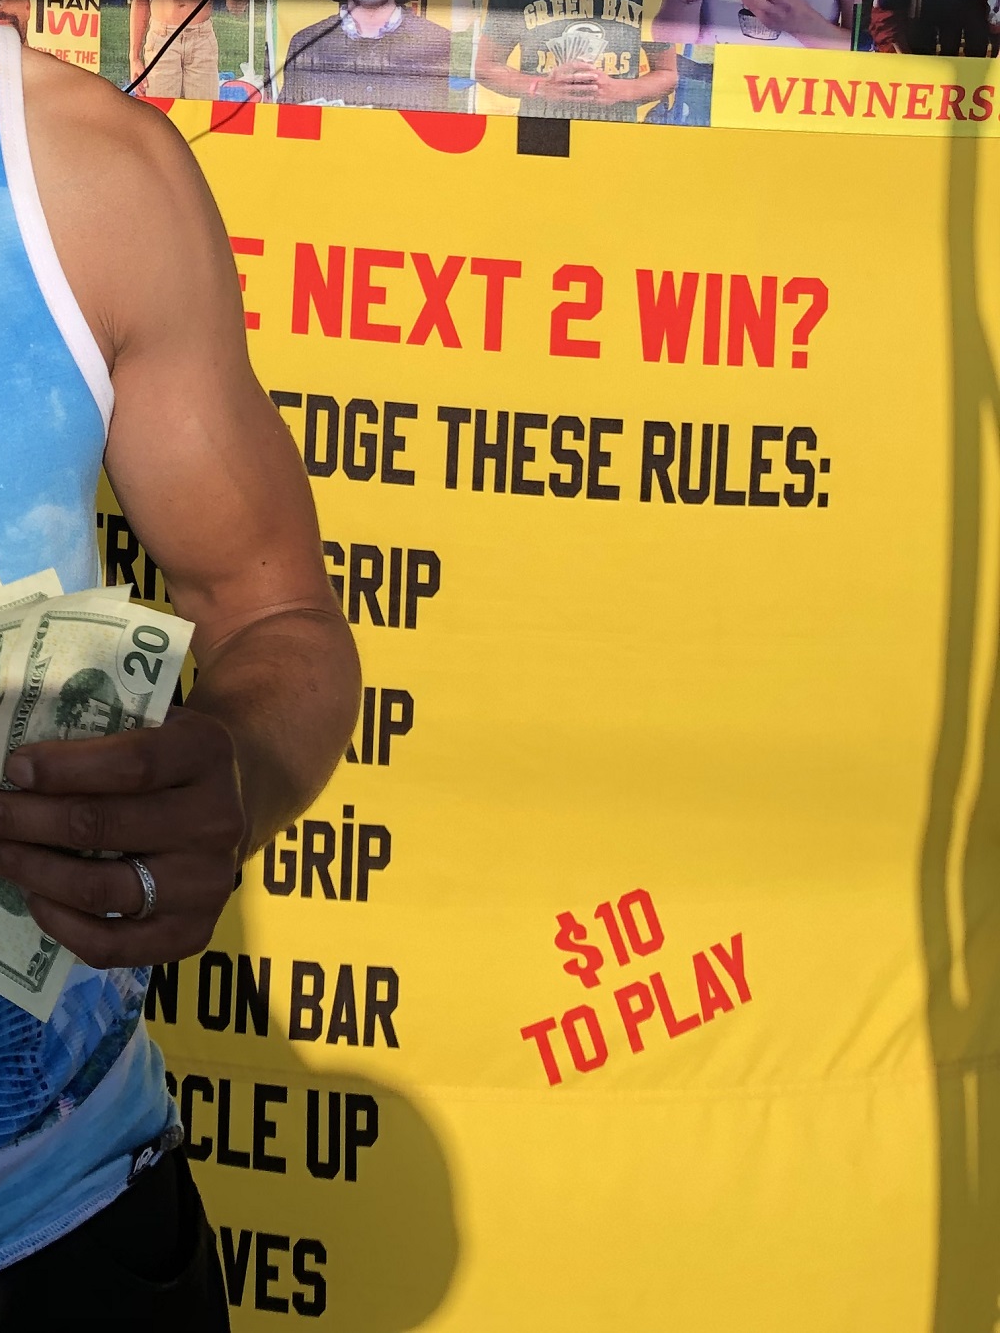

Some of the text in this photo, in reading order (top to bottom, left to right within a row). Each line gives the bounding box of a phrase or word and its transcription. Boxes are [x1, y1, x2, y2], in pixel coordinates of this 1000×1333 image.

[74, 50, 98, 64] THE
[290, 243, 522, 353] NEXT
[549, 263, 604, 360] 2
[636, 268, 829, 369] WIN?
[437, 406, 624, 501] THESE
[640, 421, 832, 509] RULES:
[123, 623, 171, 686] 20
[554, 888, 665, 989] $10
[198, 950, 272, 1037] ON
[289, 960, 400, 1049] BAR
[520, 932, 753, 1087] TO PLAY
[306, 1088, 379, 1184] UP
